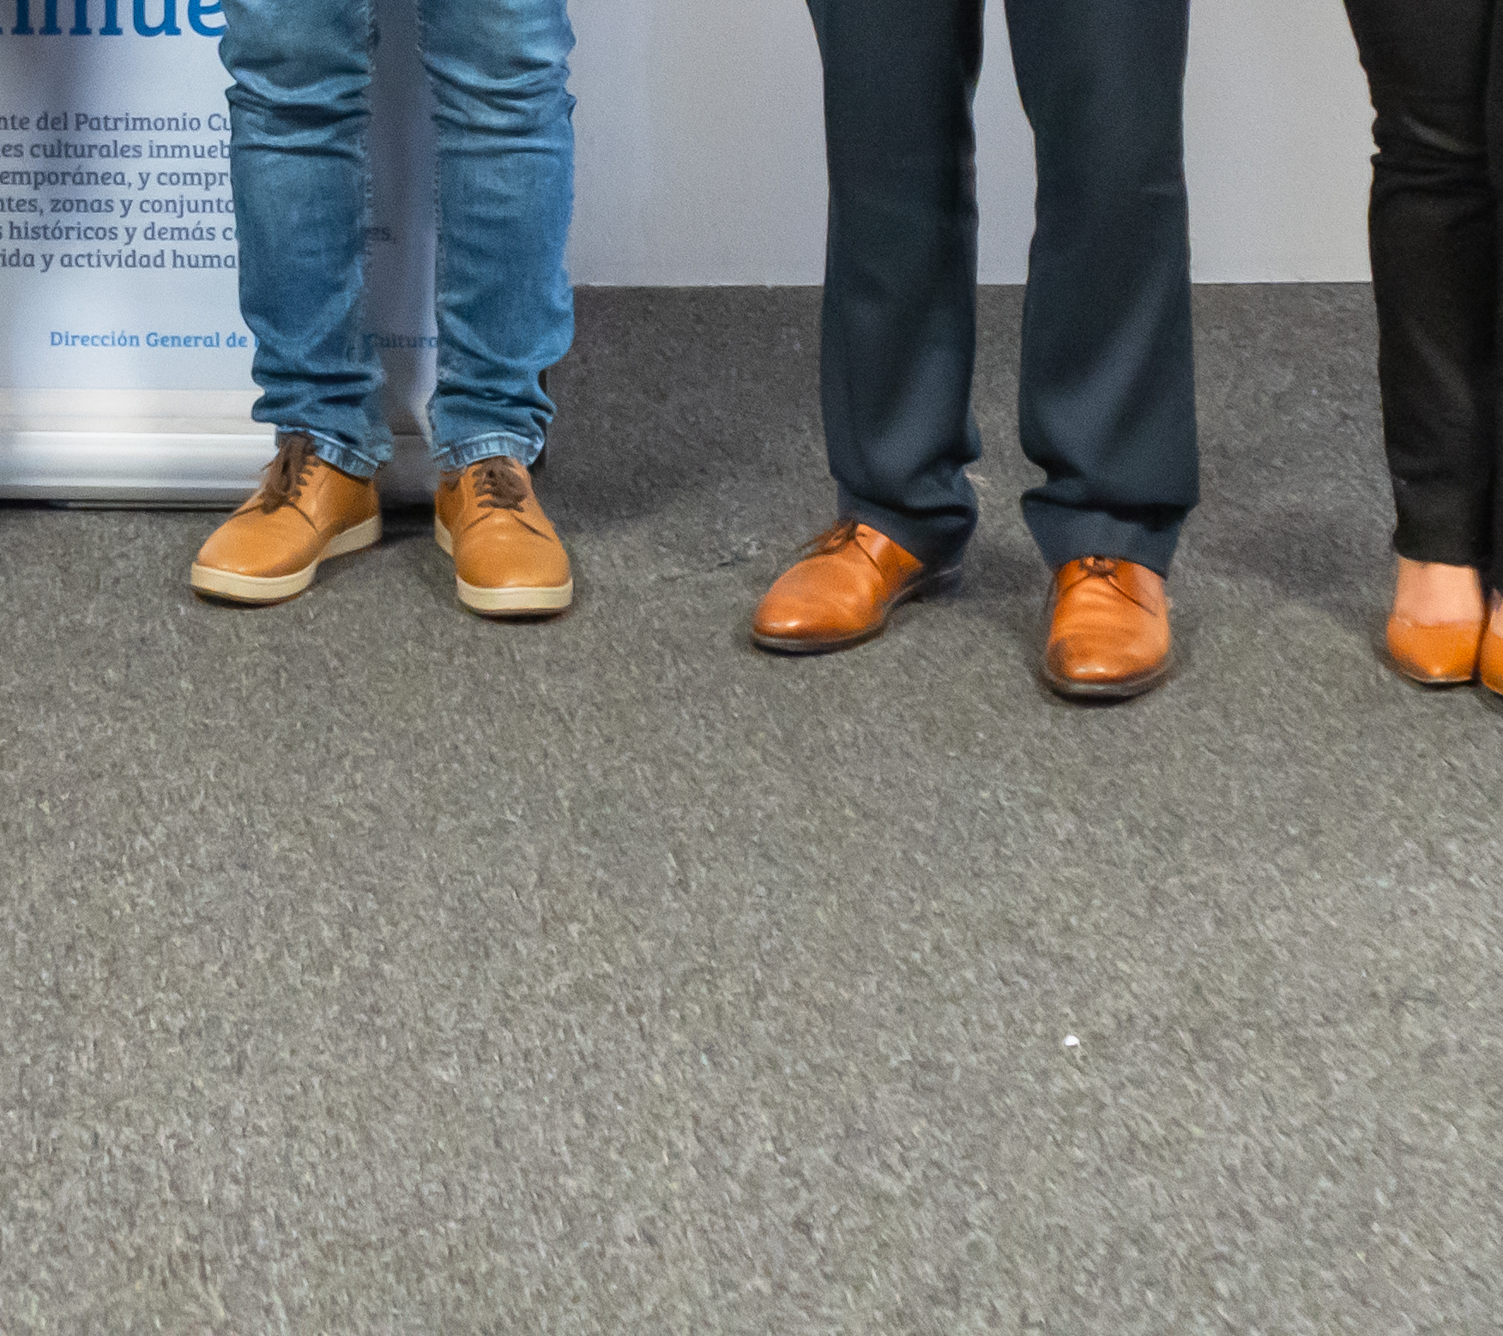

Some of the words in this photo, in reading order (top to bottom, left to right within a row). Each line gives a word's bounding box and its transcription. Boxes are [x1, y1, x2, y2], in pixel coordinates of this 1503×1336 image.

[36, 112, 68, 131] del
[74, 112, 202, 132] Patrimonio
[29, 139, 143, 159] culturales
[137, 171, 152, 191] y
[50, 198, 115, 214] zonas
[119, 199, 134, 218] y
[9, 220, 119, 241] históricos
[123, 226, 138, 246] y
[143, 221, 216, 241] demás
[40, 253, 55, 273] y
[60, 249, 165, 269] actividad
[50, 330, 141, 347] Dirección
[145, 331, 221, 348] General
[226, 332, 248, 348] de
